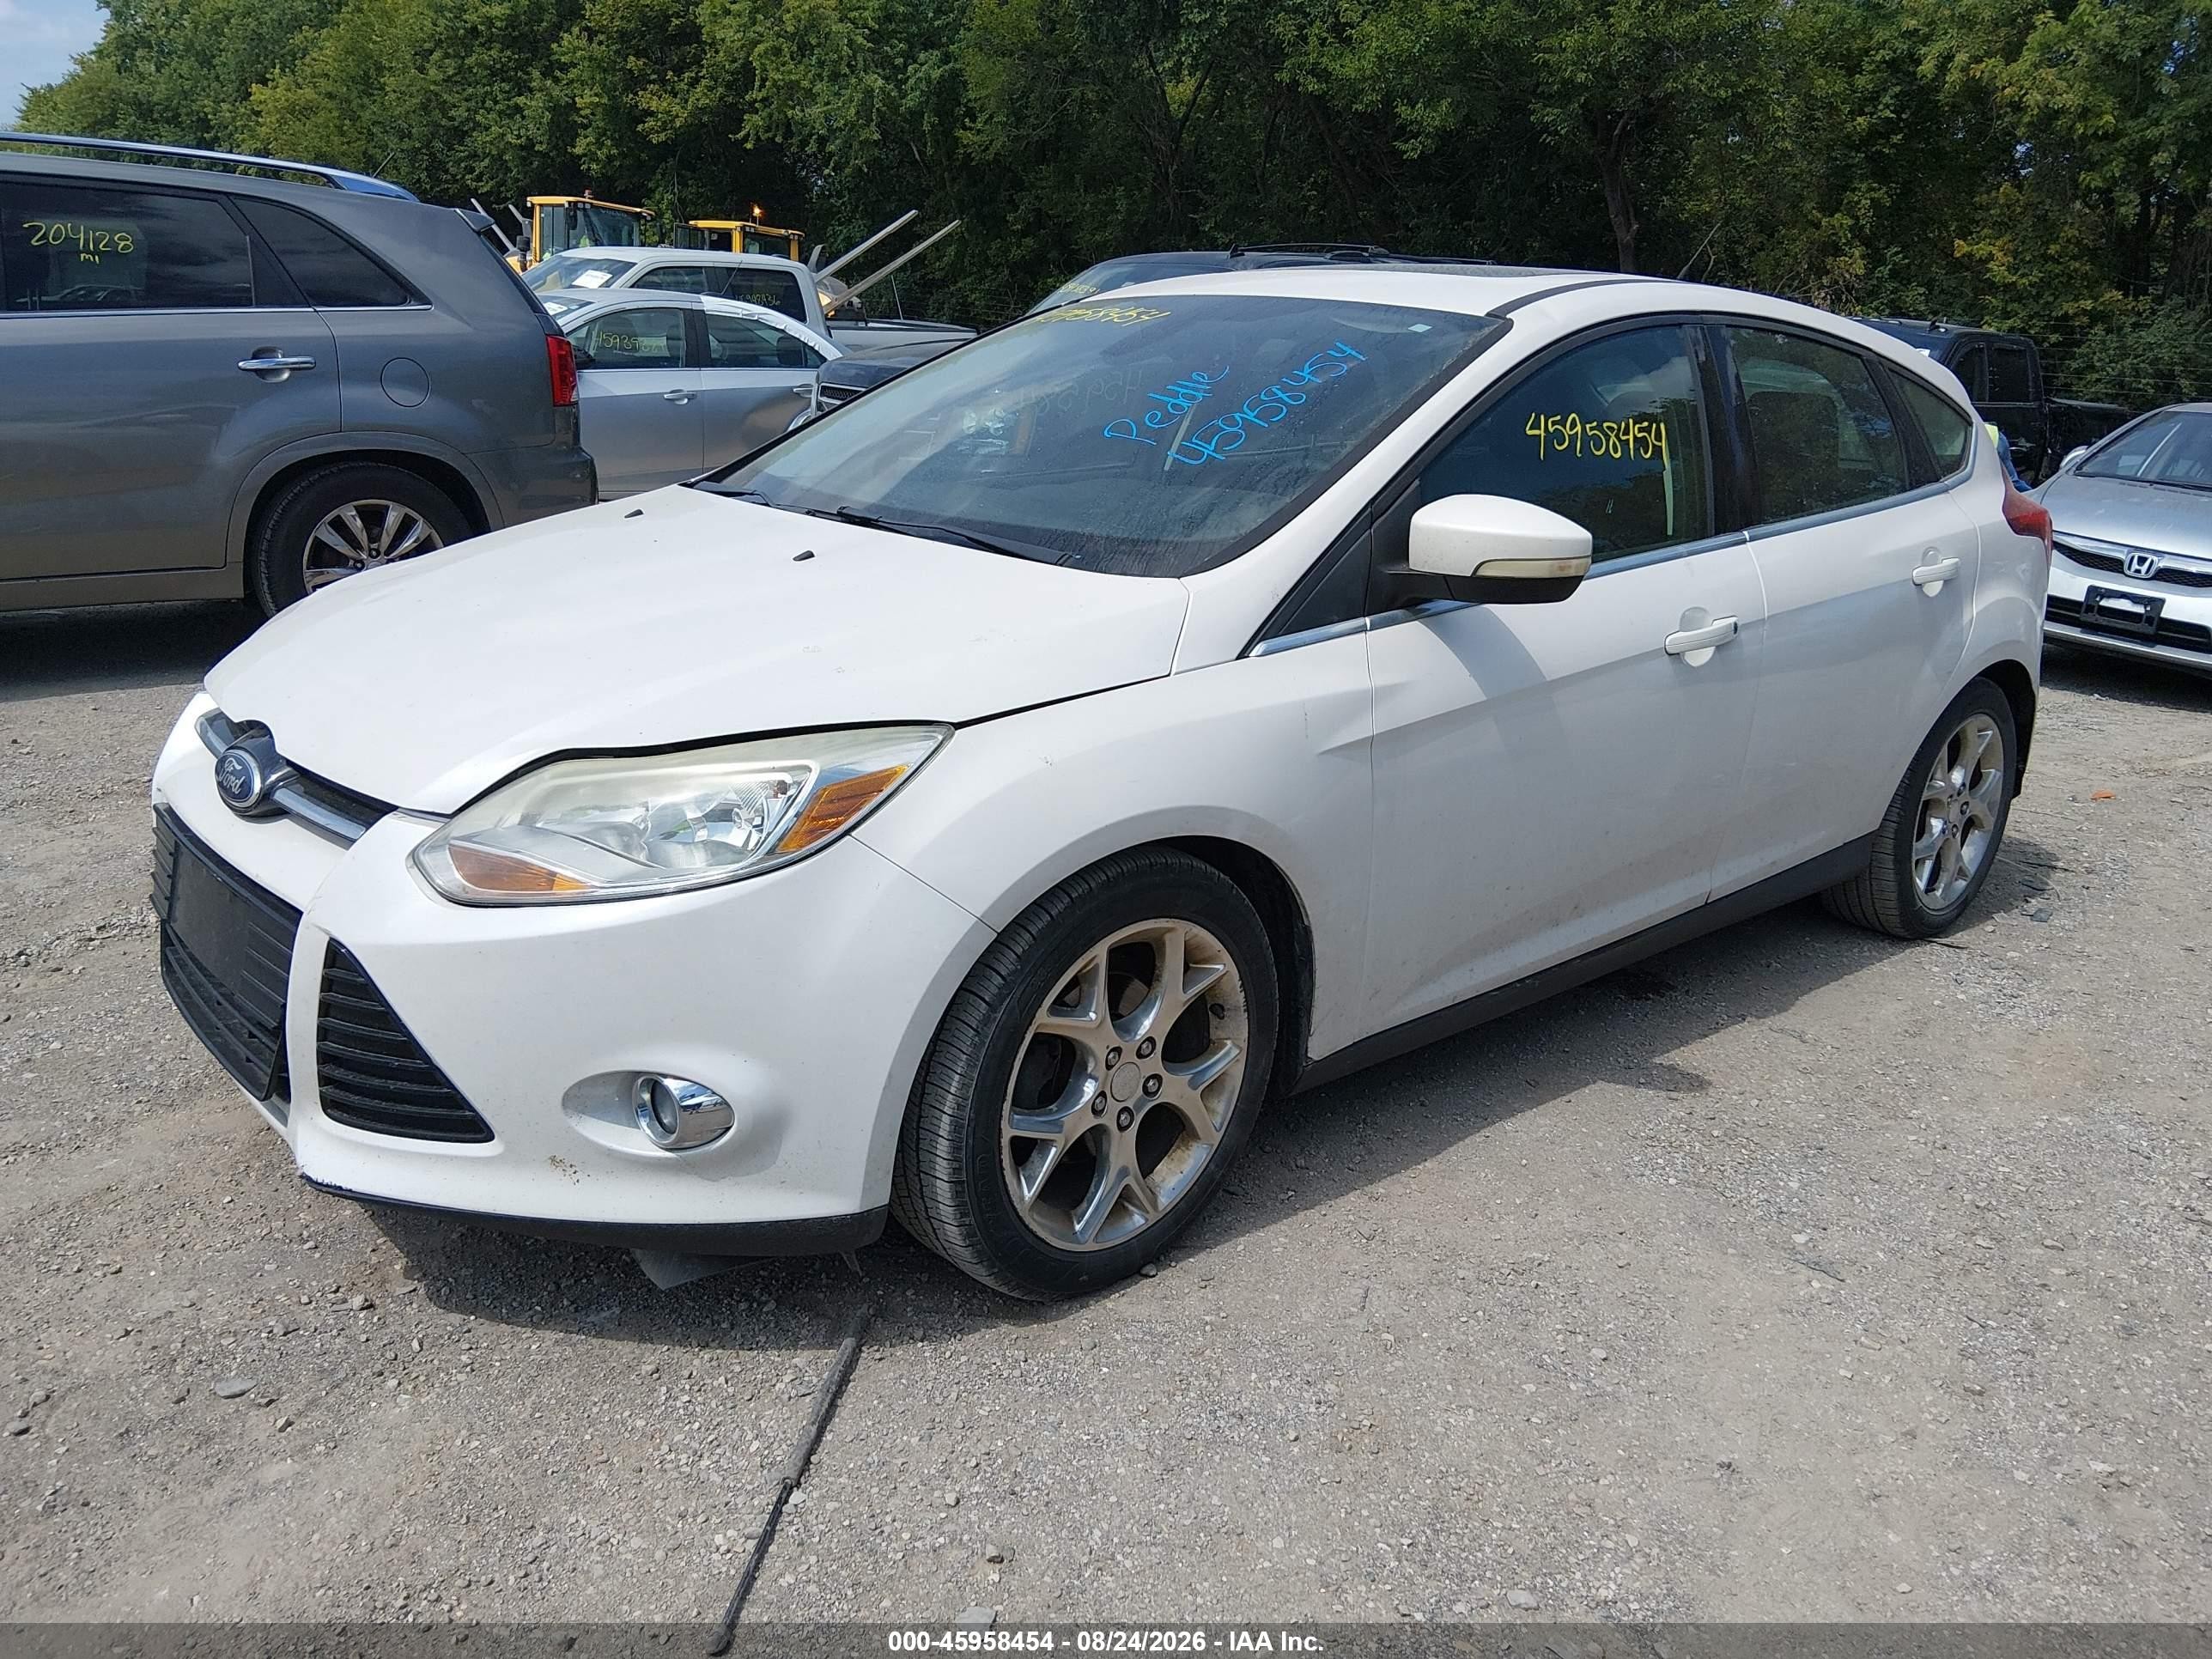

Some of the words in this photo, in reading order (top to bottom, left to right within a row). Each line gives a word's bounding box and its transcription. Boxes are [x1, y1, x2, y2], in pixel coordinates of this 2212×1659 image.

[23, 222, 134, 253] 204128
[1103, 365, 1230, 445] Peddle
[1167, 341, 1368, 465] 45958454
[1525, 412, 1668, 461] 45958454
[217, 757, 246, 794] Ford
